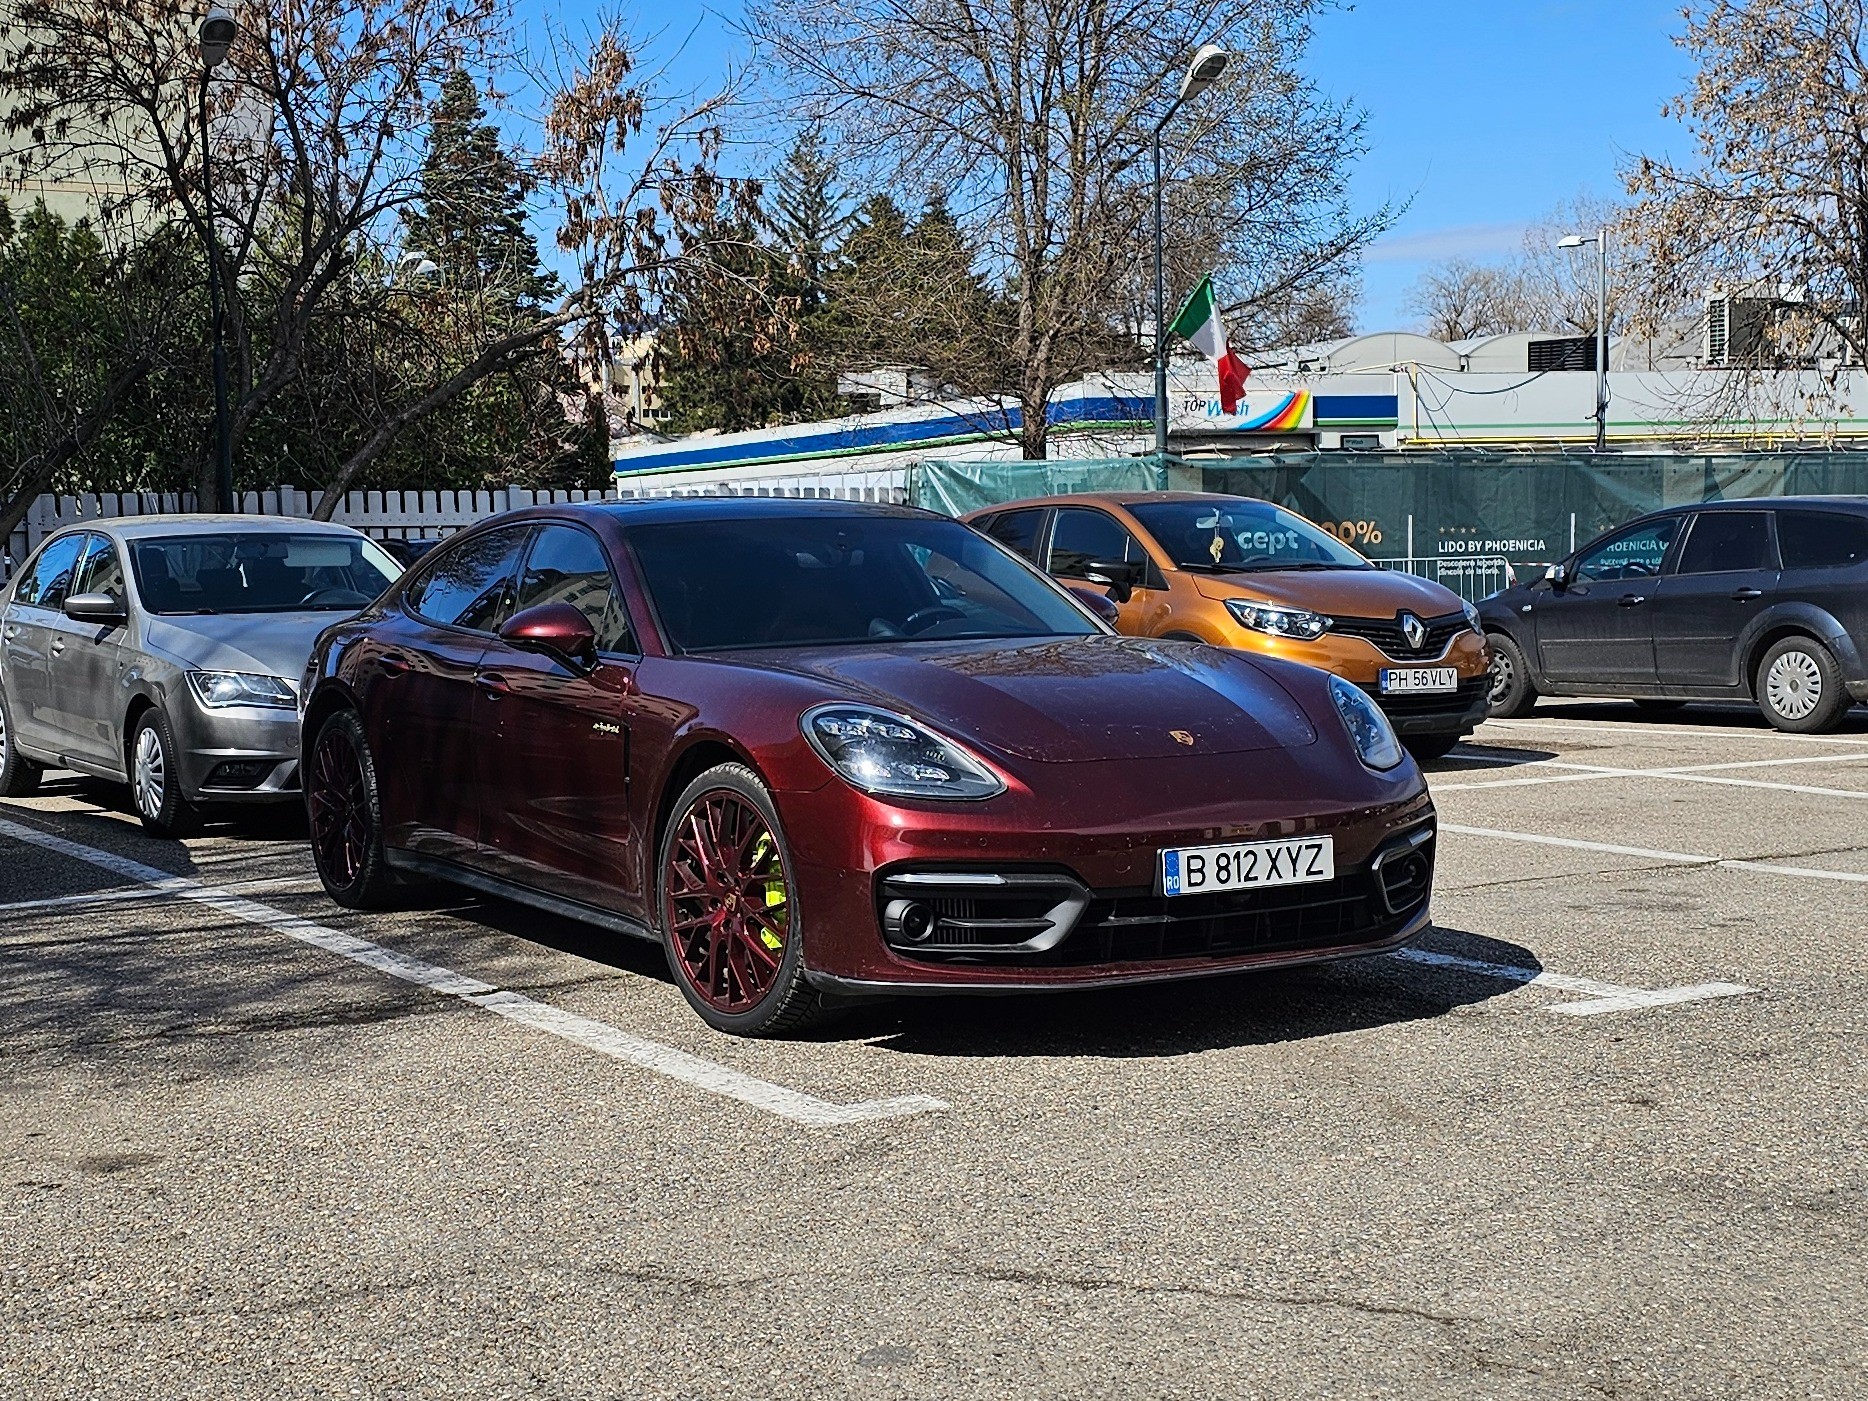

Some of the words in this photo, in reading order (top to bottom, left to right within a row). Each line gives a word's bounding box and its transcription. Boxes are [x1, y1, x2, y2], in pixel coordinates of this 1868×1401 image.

[1207, 400, 1249, 416] Wsh
[1235, 529, 1298, 555] cept
[1438, 541, 1466, 553] LIDO
[1468, 541, 1482, 552] BY
[1485, 539, 1546, 551] PHOENICIA
[1388, 671, 1408, 688] PH
[1186, 854, 1206, 888] B
[1166, 875, 1180, 891] RO
